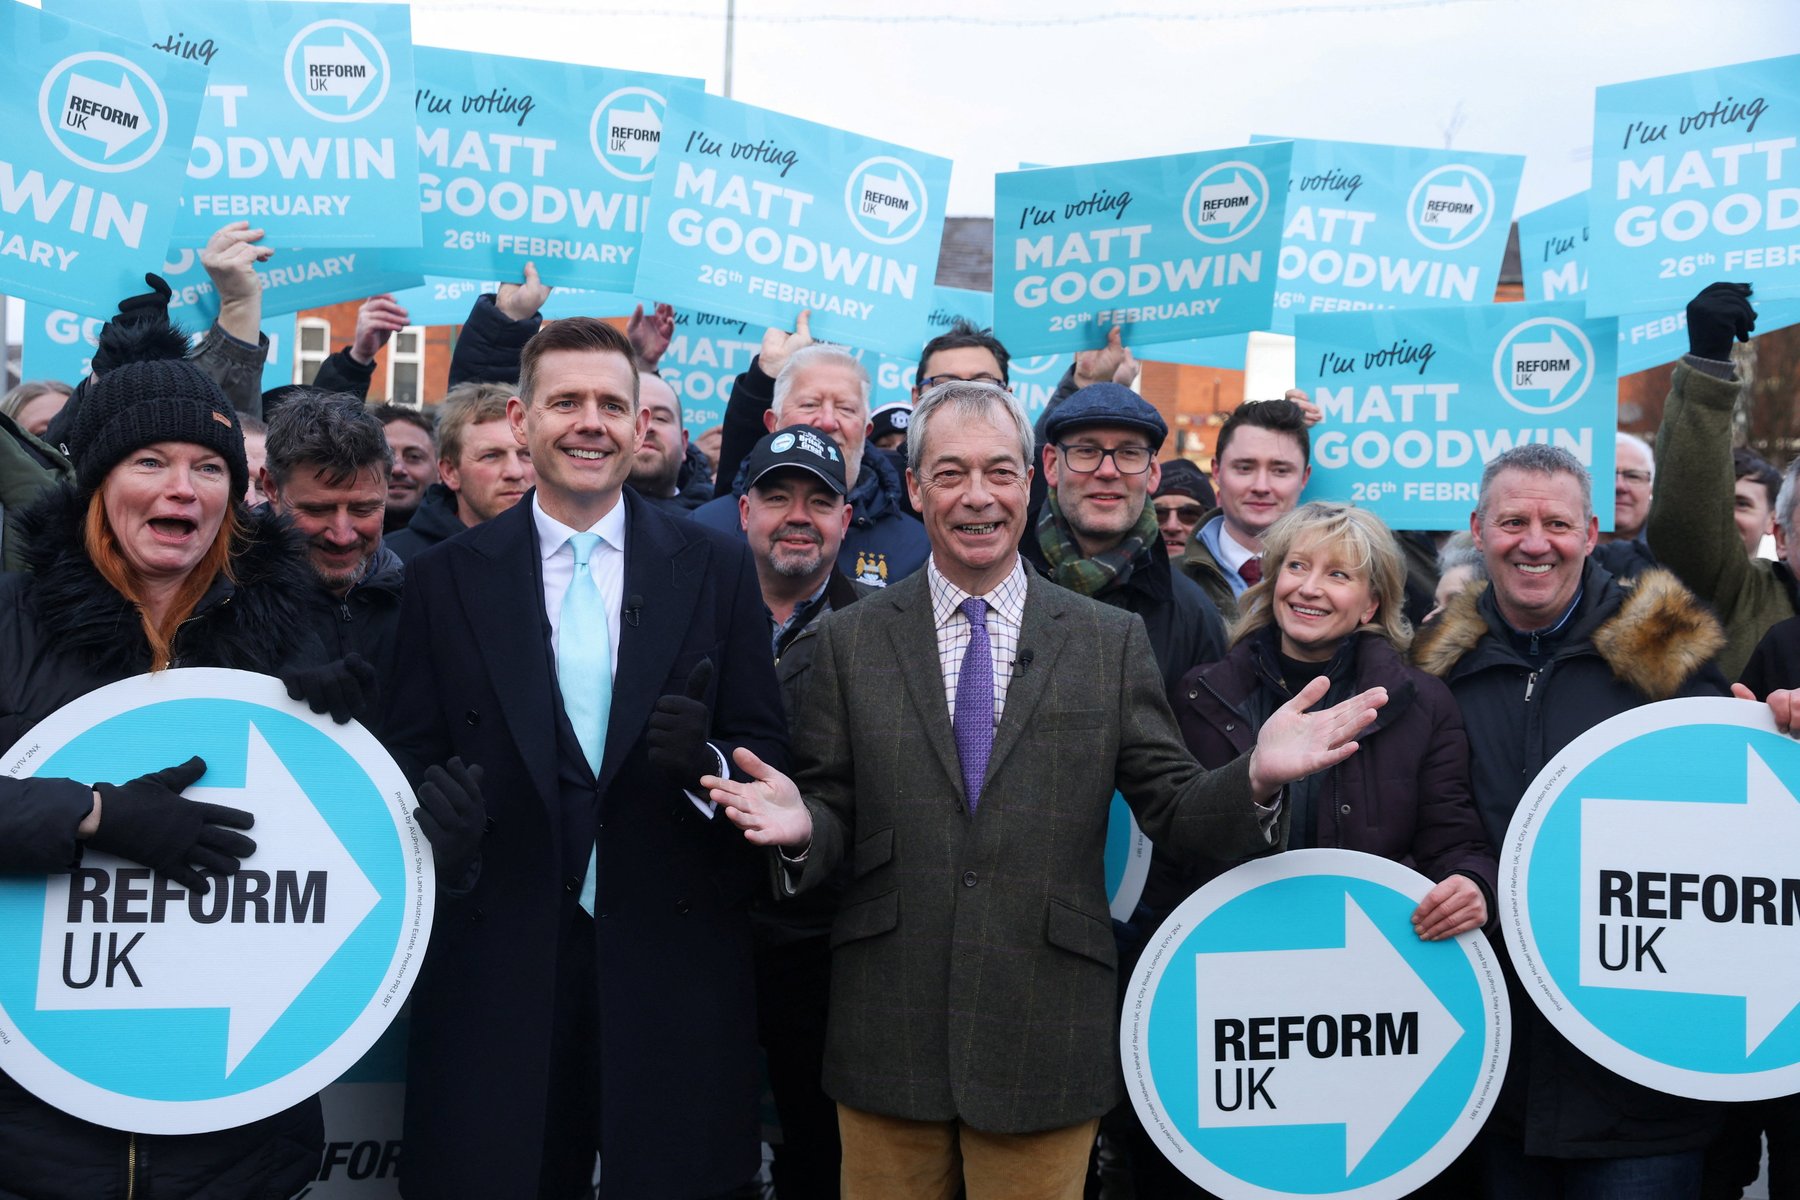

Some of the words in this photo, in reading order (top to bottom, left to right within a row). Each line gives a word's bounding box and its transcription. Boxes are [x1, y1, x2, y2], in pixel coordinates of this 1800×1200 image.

[152, 33, 219, 66] ting
[309, 64, 366, 78] REFORM
[310, 78, 328, 91] UK
[69, 95, 139, 130] REFORM
[462, 87, 536, 127] voting
[66, 111, 88, 131] UK
[1623, 121, 1667, 149] I'm
[1680, 96, 1769, 134] voting
[610, 139, 626, 152] UK
[611, 126, 661, 142] REFORM
[185, 136, 396, 179] ODWIN
[416, 125, 557, 177] MATT
[685, 131, 721, 158] I'm
[730, 140, 799, 178] voting
[1617, 136, 1797, 200] MATT
[673, 161, 814, 228] MATT
[1300, 168, 1363, 201] voting
[194, 195, 351, 216] FEBRUARY
[862, 202, 877, 215] UK
[864, 189, 909, 211] REFORM
[1019, 205, 1055, 229] I'm
[1064, 189, 1133, 220] voting
[1203, 196, 1249, 210] REFORM
[1427, 200, 1473, 214] REFORM
[1201, 211, 1216, 222] UK
[1283, 205, 1376, 246] ATT
[1424, 212, 1439, 223] UK
[1614, 187, 1800, 248] GOOD
[443, 229, 491, 250] 26th
[498, 234, 634, 265] FEBRUARY
[667, 208, 918, 300] GOODWIN
[1015, 224, 1152, 271] MATT
[1277, 245, 1480, 302] OODWIN
[1659, 252, 1715, 279] 26th
[1724, 244, 1800, 272] FEBR
[169, 282, 214, 308] 26th
[258, 254, 356, 290] BRUARY
[434, 282, 475, 300] 26th
[1014, 251, 1262, 308] GOODWIN
[697, 265, 743, 287] 26th
[748, 275, 874, 321] FEBRUARY
[1049, 312, 1092, 332] 26th
[1097, 298, 1221, 326] FEBRUARY
[1319, 352, 1354, 377] I'm
[1365, 338, 1436, 374] voting
[1516, 359, 1570, 373] REFORM
[1515, 373, 1533, 386] UK
[684, 408, 719, 424] 26th
[1314, 383, 1459, 424] MATT
[1351, 481, 1396, 501] 26th
[26, 744, 40, 758] 2NX
[395, 791, 409, 815] Printed
[1531, 790, 1547, 812] London
[405, 815, 411, 824] by
[1518, 828, 1528, 841] City
[1510, 865, 1518, 889] Reform
[67, 867, 328, 925] REFORM
[1511, 889, 1517, 897] of
[414, 895, 423, 926] Industrial
[1511, 897, 1519, 917] behalf
[1515, 918, 1520, 927] on
[61, 931, 146, 989] UK
[1150, 949, 1164, 970] London
[1472, 941, 1485, 961] Printed
[1598, 923, 1668, 973] UK
[398, 953, 412, 978] Preston
[390, 979, 401, 993] PR3
[1540, 984, 1562, 1011] Promoted
[1214, 1011, 1419, 1062] REFORM
[1137, 1070, 1142, 1078] on
[1214, 1066, 1277, 1111] UK
[1163, 1130, 1183, 1153] Promoted
